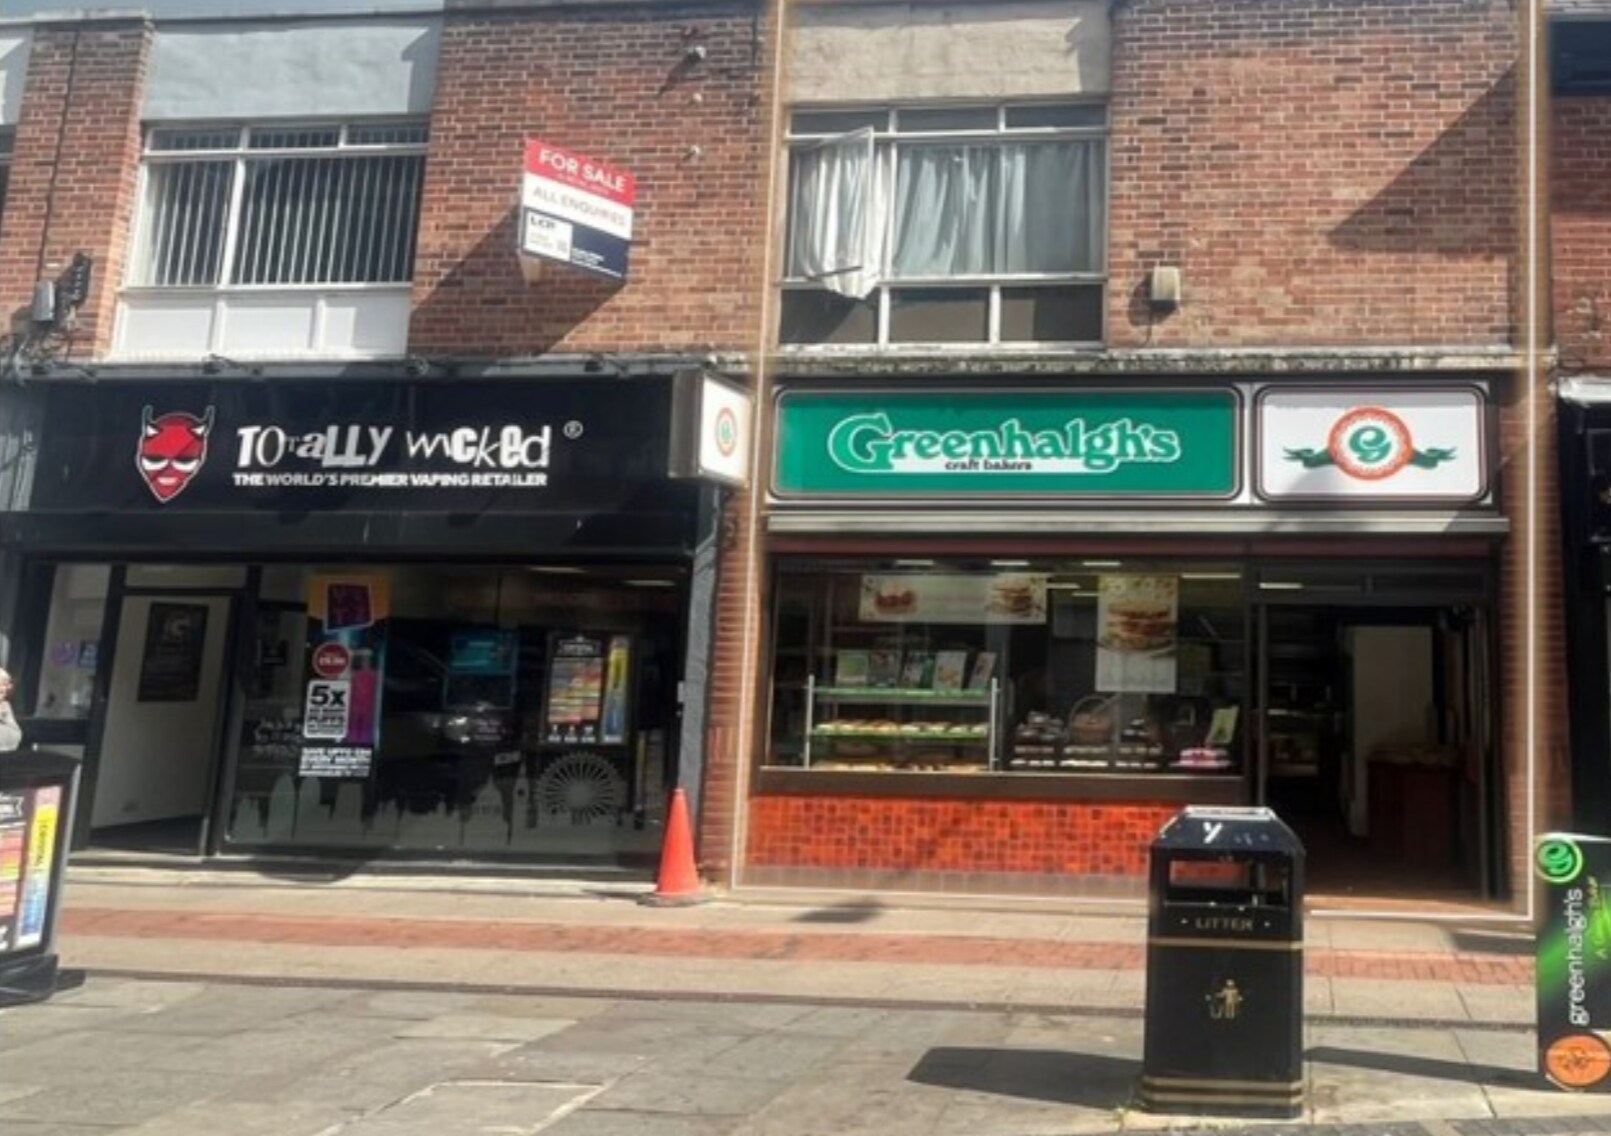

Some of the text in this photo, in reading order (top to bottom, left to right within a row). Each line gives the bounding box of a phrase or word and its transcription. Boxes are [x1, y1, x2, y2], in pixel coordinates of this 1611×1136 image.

[539, 148, 579, 176] FOR
[581, 161, 626, 193] SALE
[532, 185, 558, 205] ALL
[827, 412, 1182, 474] Greenhalgh's
[945, 459, 1033, 472] craft bakers
[232, 472, 548, 487] THE WORLD'S PREMIER VAPING RETAILER
[309, 685, 347, 707] 5x
[1195, 916, 1254, 931] LITTER
